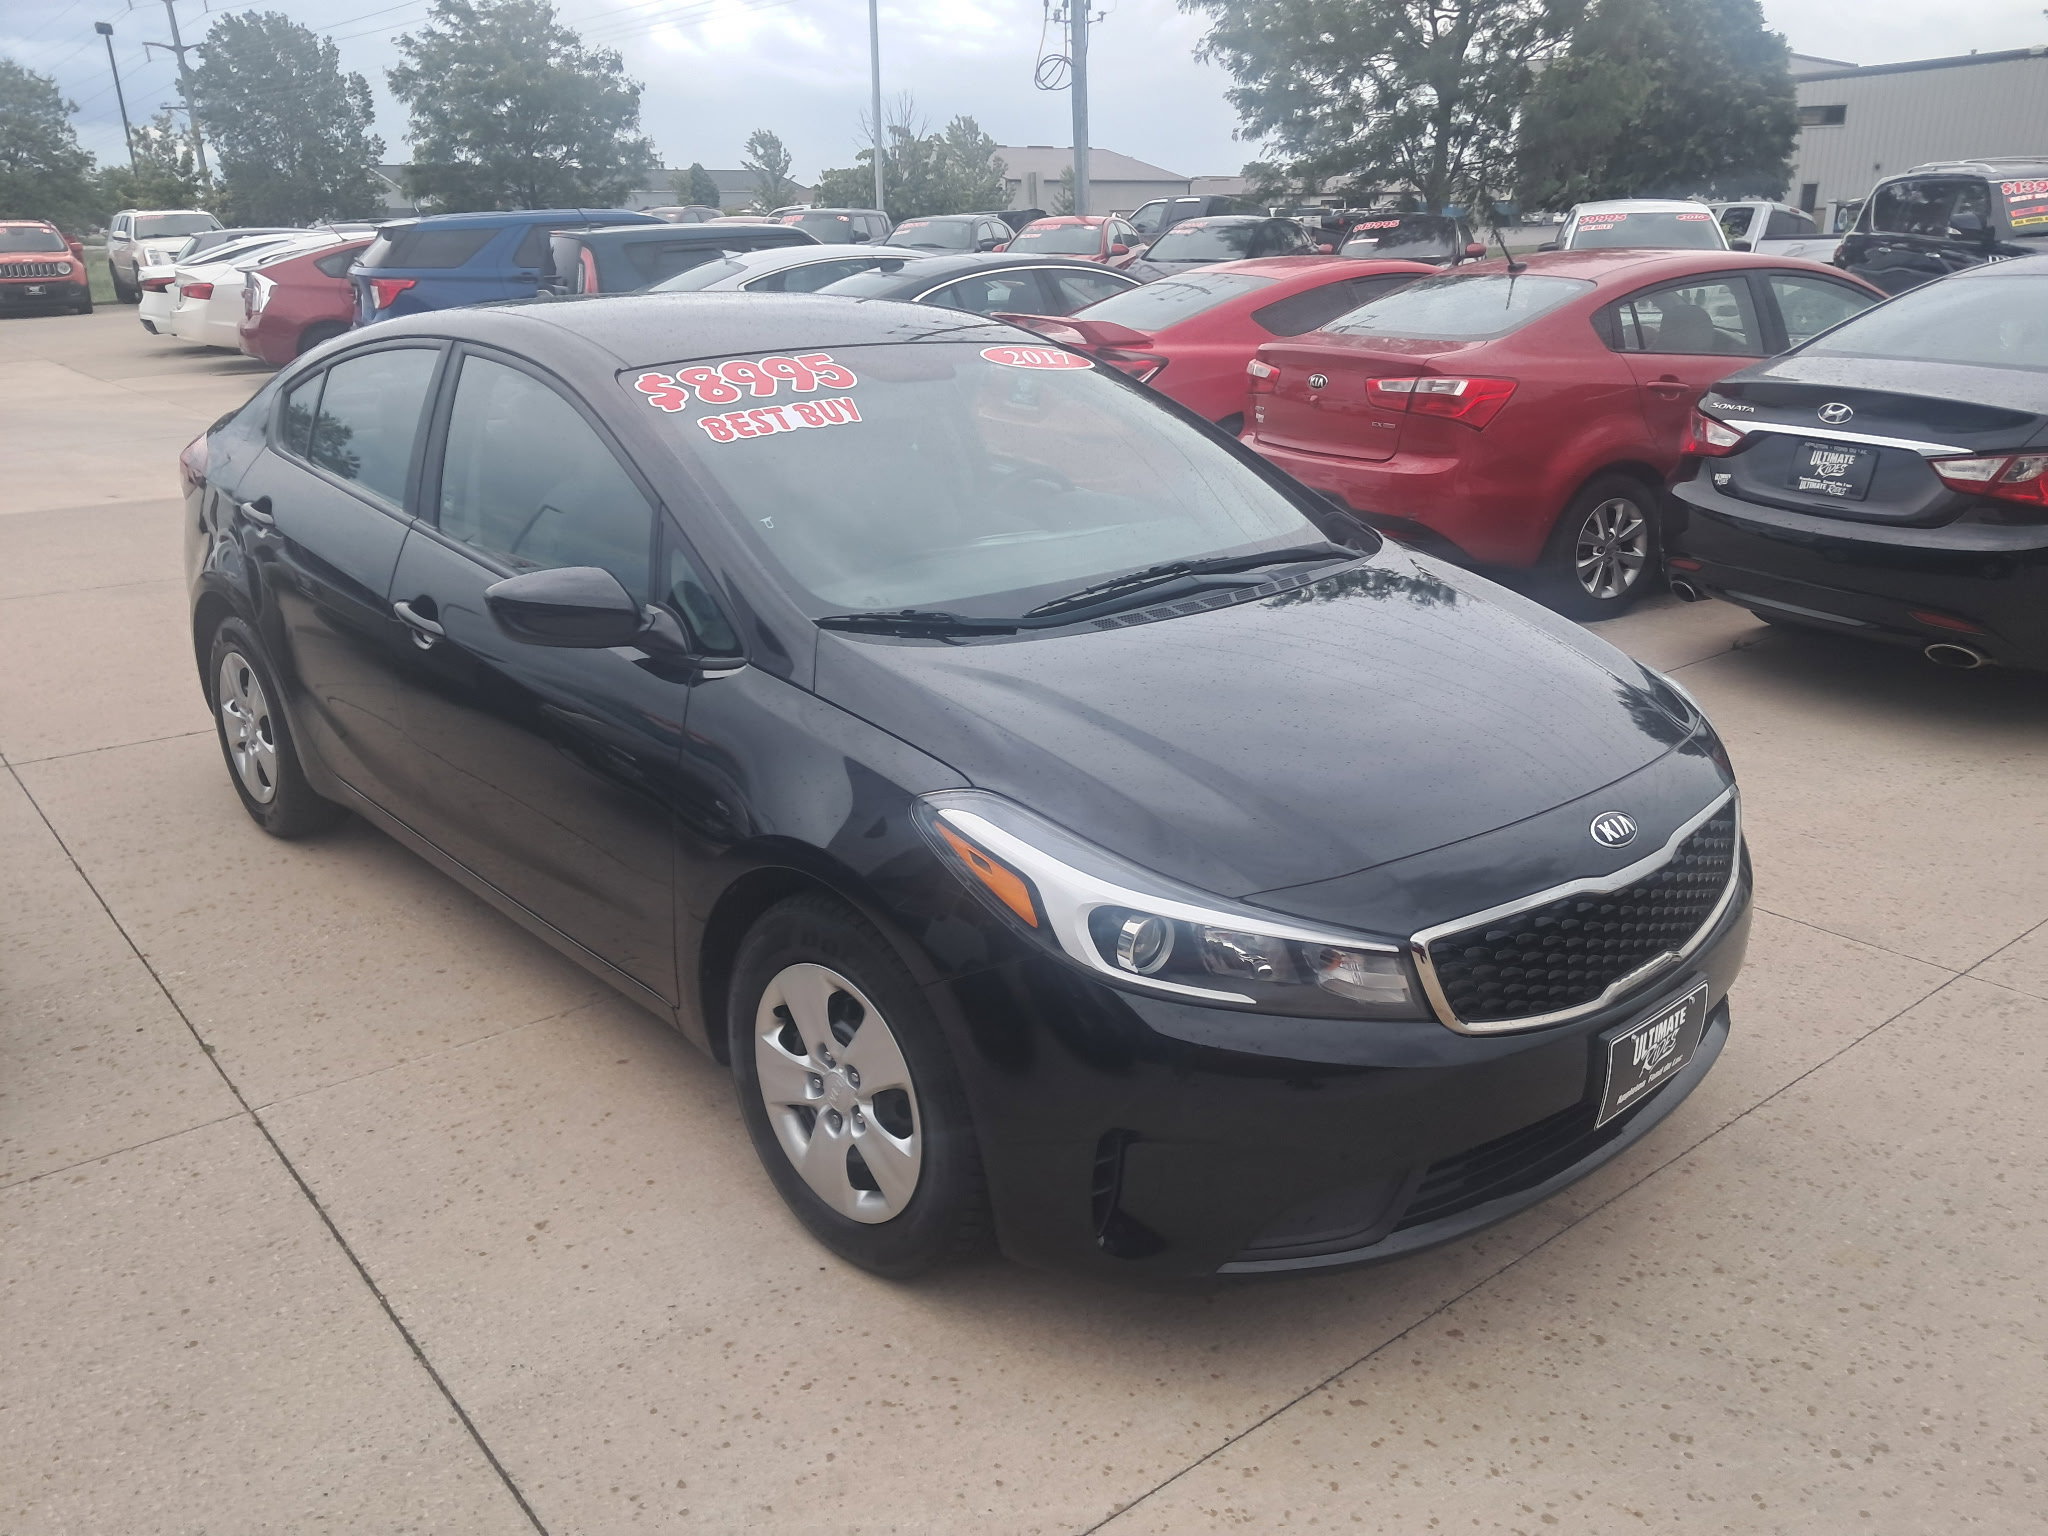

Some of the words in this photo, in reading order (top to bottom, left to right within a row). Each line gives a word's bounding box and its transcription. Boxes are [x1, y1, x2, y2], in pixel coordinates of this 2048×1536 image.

[1003, 350, 1070, 366] 2017
[634, 353, 857, 412] $8995
[1710, 402, 1755, 413] SONATA
[698, 405, 791, 443] BEST
[793, 397, 862, 428] BUY
[1810, 450, 1856, 466] ULTIMATE
[1799, 481, 1827, 490] ULTIMATE
[1597, 815, 1635, 842] KIA
[1632, 1006, 1687, 1066] ULTIMATE
